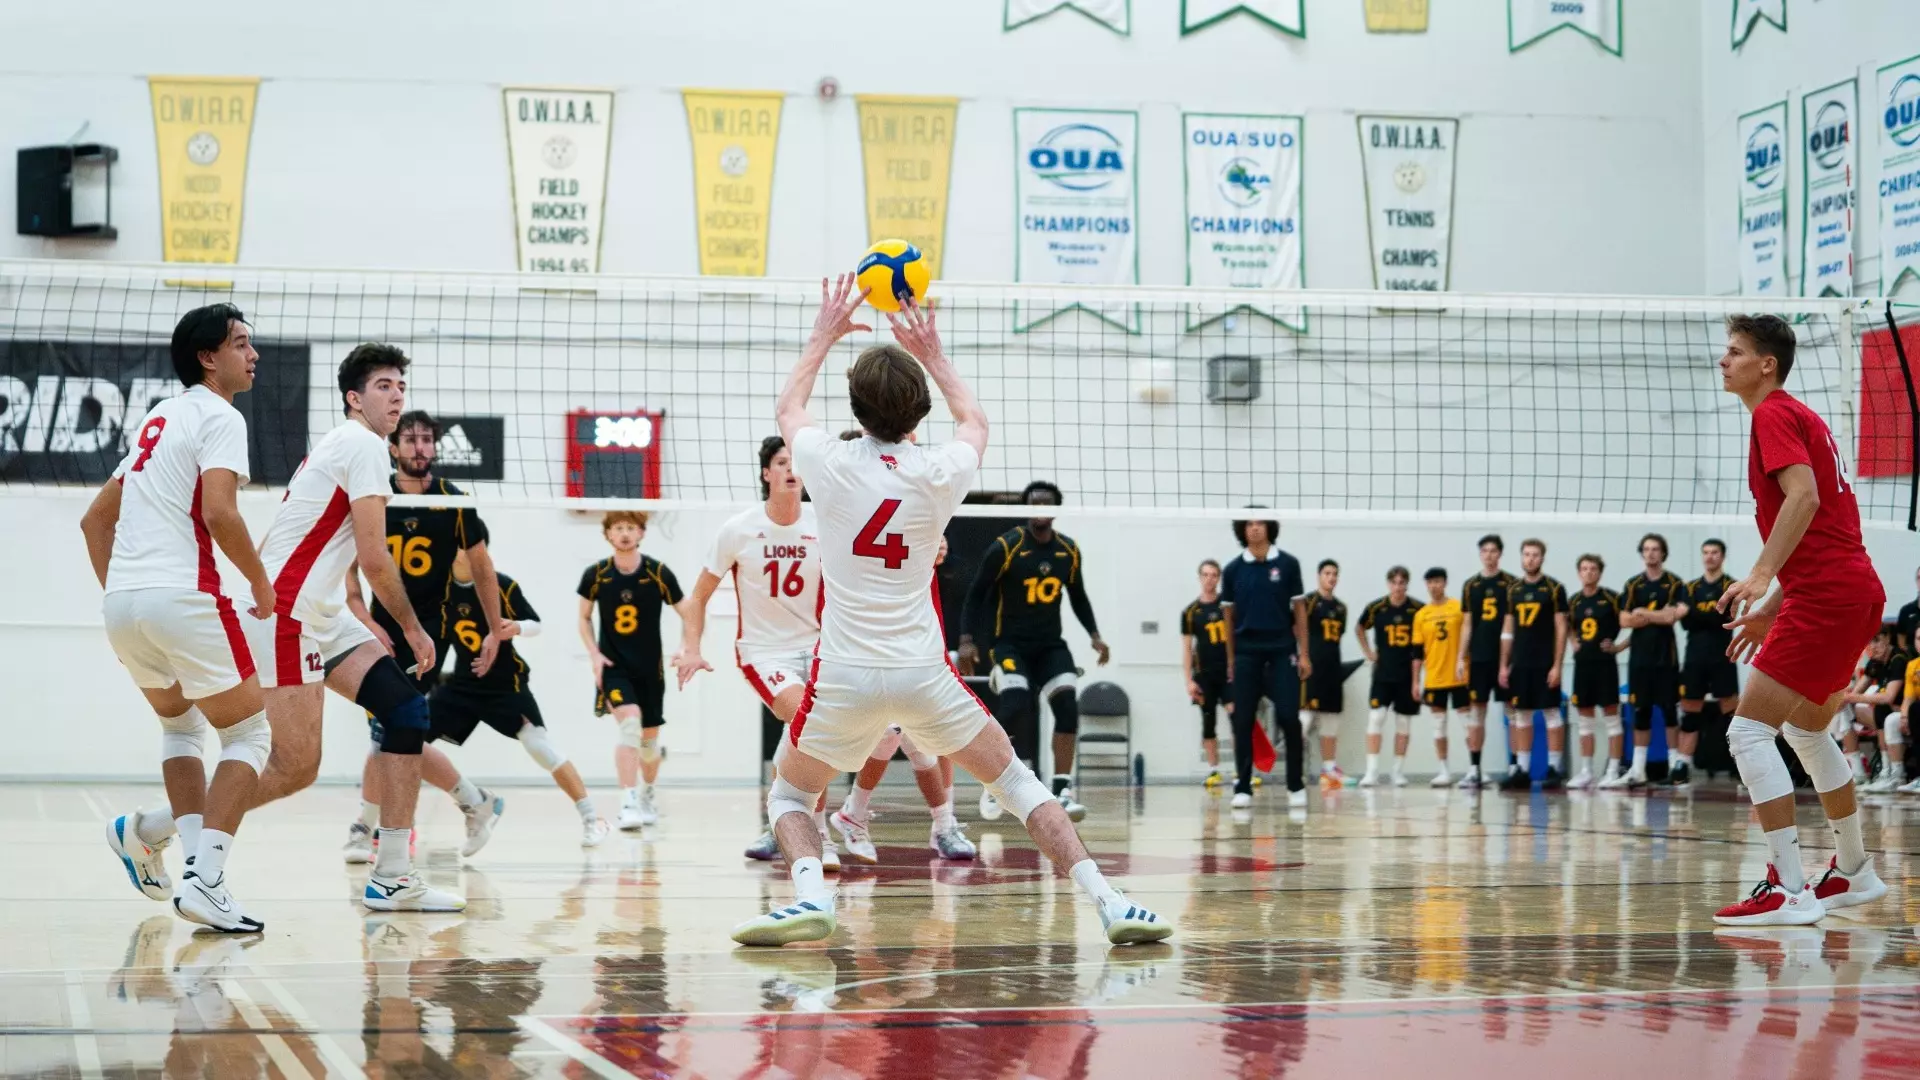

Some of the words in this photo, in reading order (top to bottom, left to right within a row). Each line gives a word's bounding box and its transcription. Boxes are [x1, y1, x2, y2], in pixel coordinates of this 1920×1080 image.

[1810, 121, 1849, 153] OUA
[1028, 149, 1124, 170] OUA
[539, 178, 579, 196] FIELD
[170, 201, 233, 221] HOCKEY
[531, 202, 587, 220] HOCKEY
[1382, 209, 1435, 228] TENNIS
[528, 225, 589, 245] CHAMPS
[1024, 215, 1131, 234] CHAMPIONS
[1190, 216, 1295, 235] CHAMPIONS
[1212, 242, 1277, 254] Women's
[1382, 248, 1438, 268] CHAMPS
[1222, 257, 1269, 269] Tennis
[131, 416, 167, 472] 9
[852, 498, 910, 570] 4
[386, 534, 433, 577] 16
[763, 545, 807, 559] LIONS
[763, 560, 805, 598] 16
[1023, 576, 1062, 604] 10
[614, 603, 638, 635] 8
[1481, 597, 1498, 621] 5
[1515, 602, 1541, 627] 17
[453, 619, 483, 653] 6
[1384, 623, 1410, 647] 15
[1435, 620, 1449, 641] 3
[1581, 617, 1598, 641] 9
[305, 651, 324, 672] 12
[767, 670, 787, 687] 16
